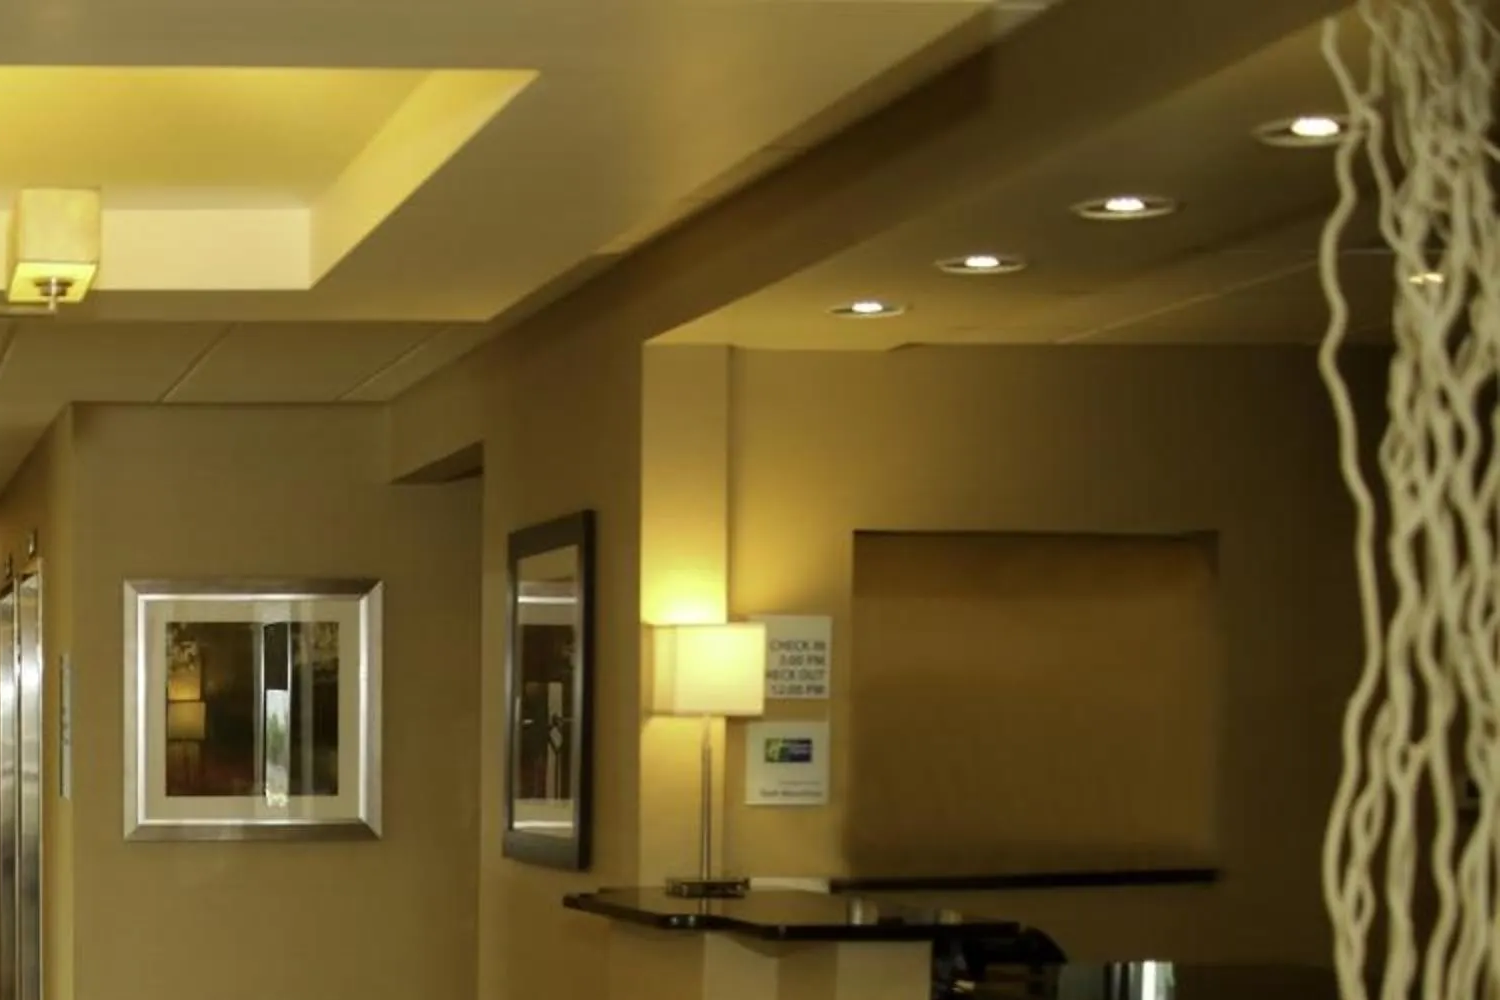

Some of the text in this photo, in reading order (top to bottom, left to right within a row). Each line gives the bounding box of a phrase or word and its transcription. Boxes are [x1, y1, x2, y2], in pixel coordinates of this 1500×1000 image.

[769, 640, 809, 651] CHECK
[806, 654, 826, 666] PM
[765, 668, 825, 680] HECK OUT
